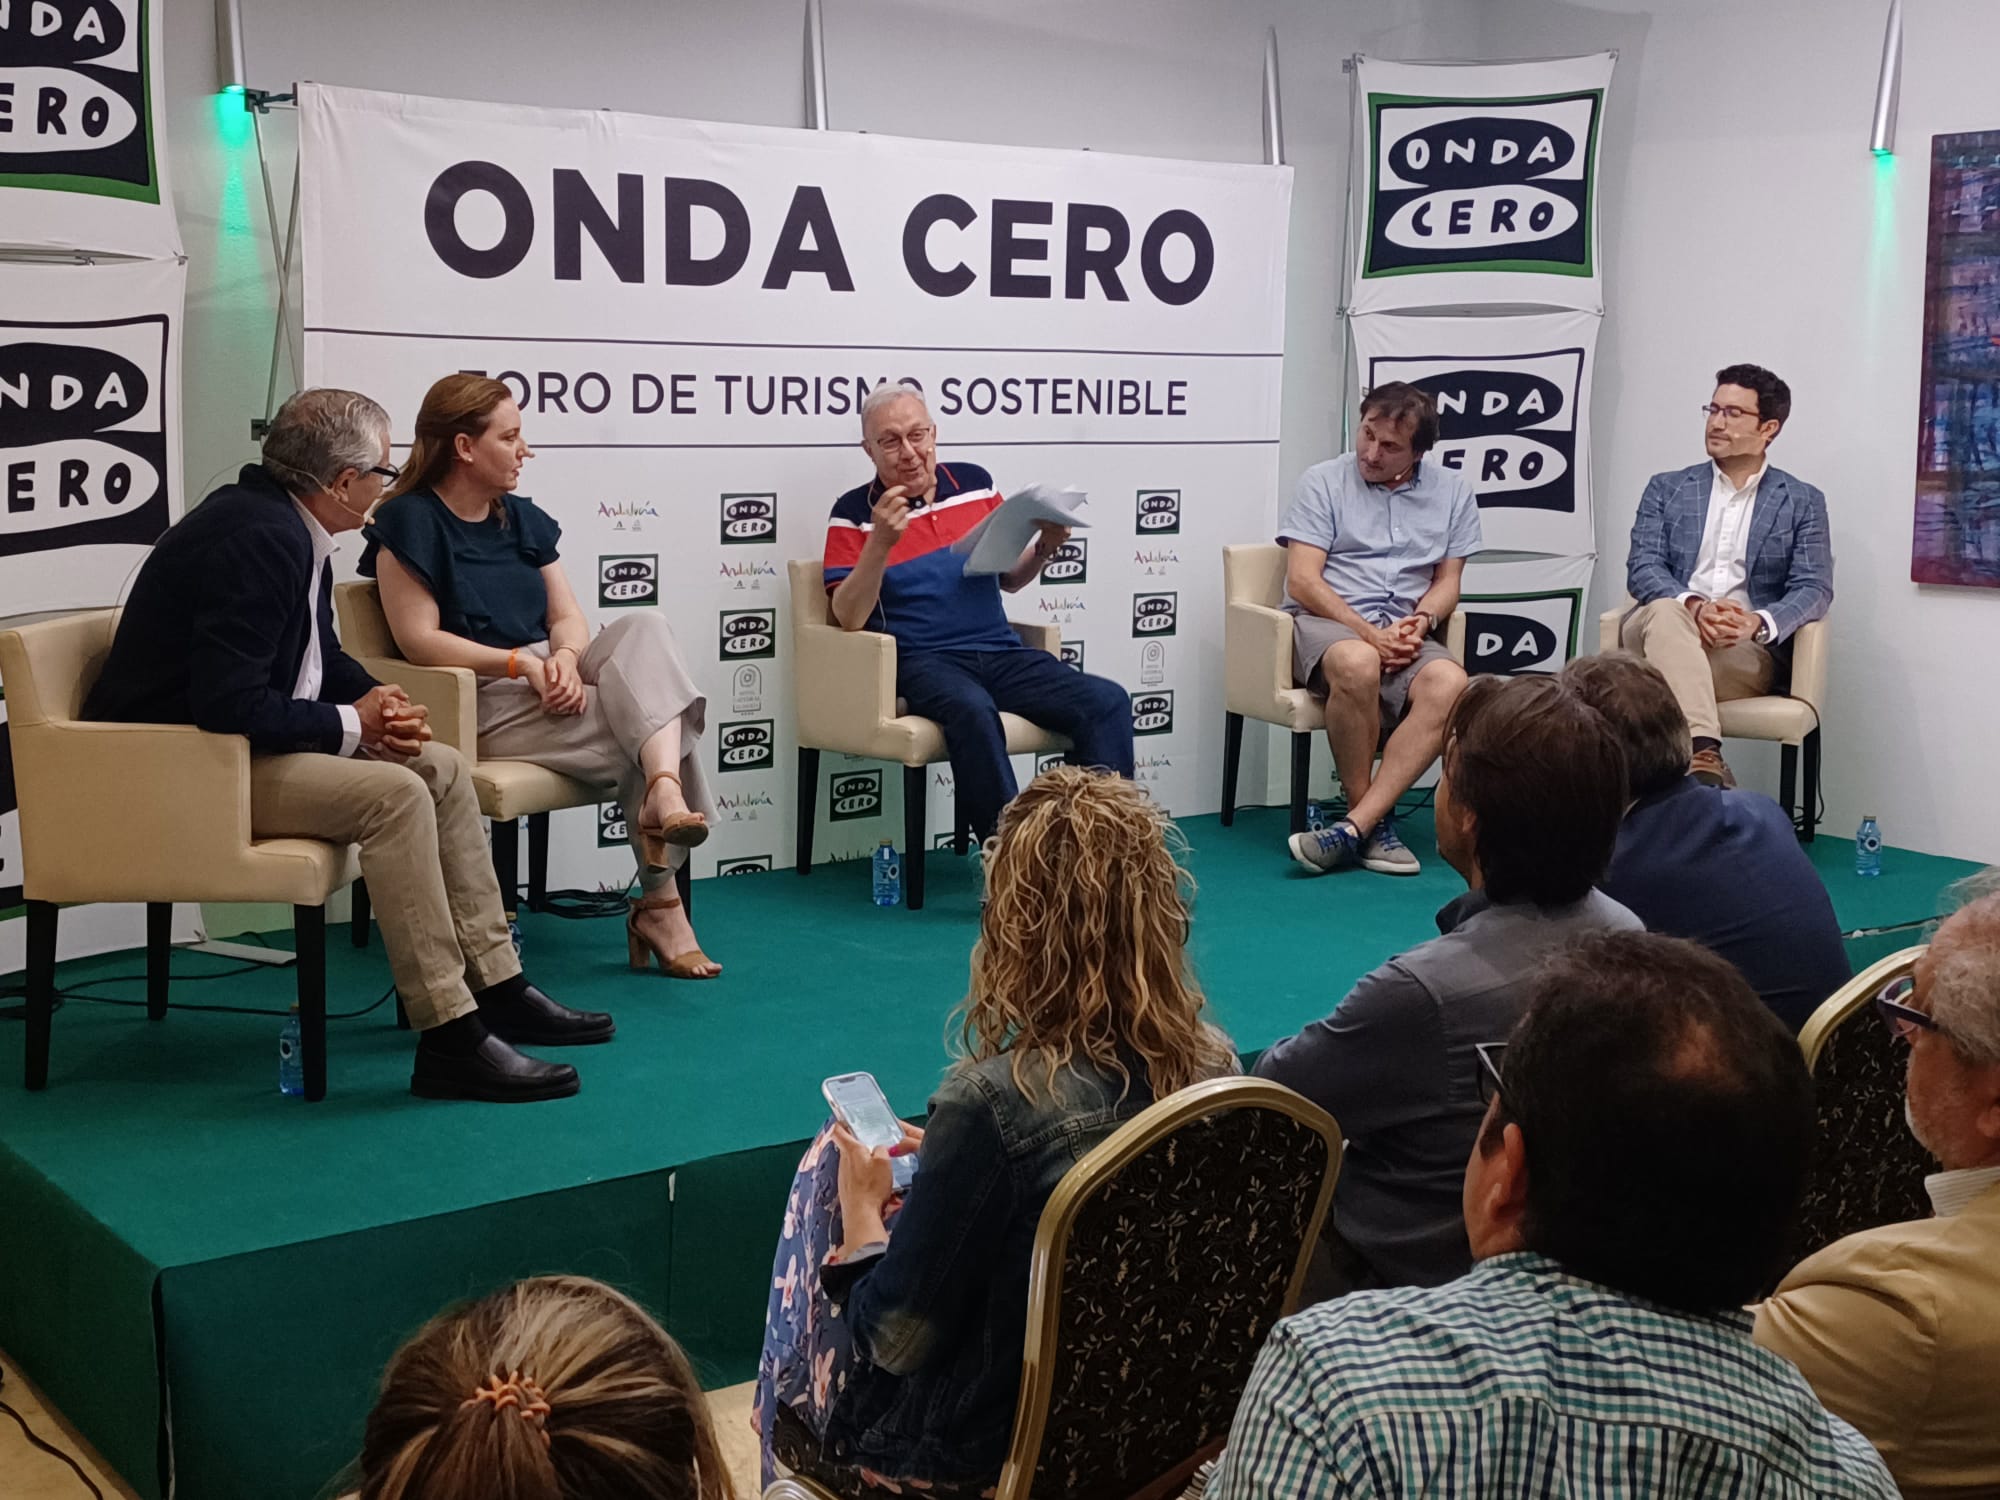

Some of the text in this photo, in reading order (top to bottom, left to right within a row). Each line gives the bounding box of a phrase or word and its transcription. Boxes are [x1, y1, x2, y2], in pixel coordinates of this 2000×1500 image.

[0, 0, 105, 44] DA
[0, 83, 109, 137] ERO
[1406, 136, 1556, 169] ONDA
[1411, 198, 1554, 236] CERO
[424, 160, 1215, 306] ONDA CERO
[0, 372, 128, 410] NDA
[459, 370, 1187, 416] ORO DE TURISM SOSTENIBLE
[1437, 388, 1545, 416] NDA
[1442, 448, 1544, 481] ERO
[8, 459, 131, 513] ERO
[729, 504, 768, 517] ONDA
[1144, 499, 1175, 510] ONDA
[1145, 515, 1173, 526] CERO
[732, 521, 767, 534] CERO
[1049, 547, 1079, 559] NDA
[608, 566, 648, 579] ONDA
[1050, 565, 1078, 575] CERO
[611, 583, 648, 596] CERO
[1140, 602, 1172, 612] ONDA
[729, 620, 766, 632] ONDA
[1142, 616, 1169, 627] CERO
[731, 636, 765, 649] CERO
[1476, 630, 1539, 656] DA
[1062, 652, 1075, 660] DA
[1137, 701, 1166, 711] ONDA
[1138, 716, 1166, 727] CERO
[728, 731, 765, 743] ONDA
[730, 748, 763, 761] CERO
[840, 781, 873, 793] ONDA
[840, 797, 873, 810] CERO
